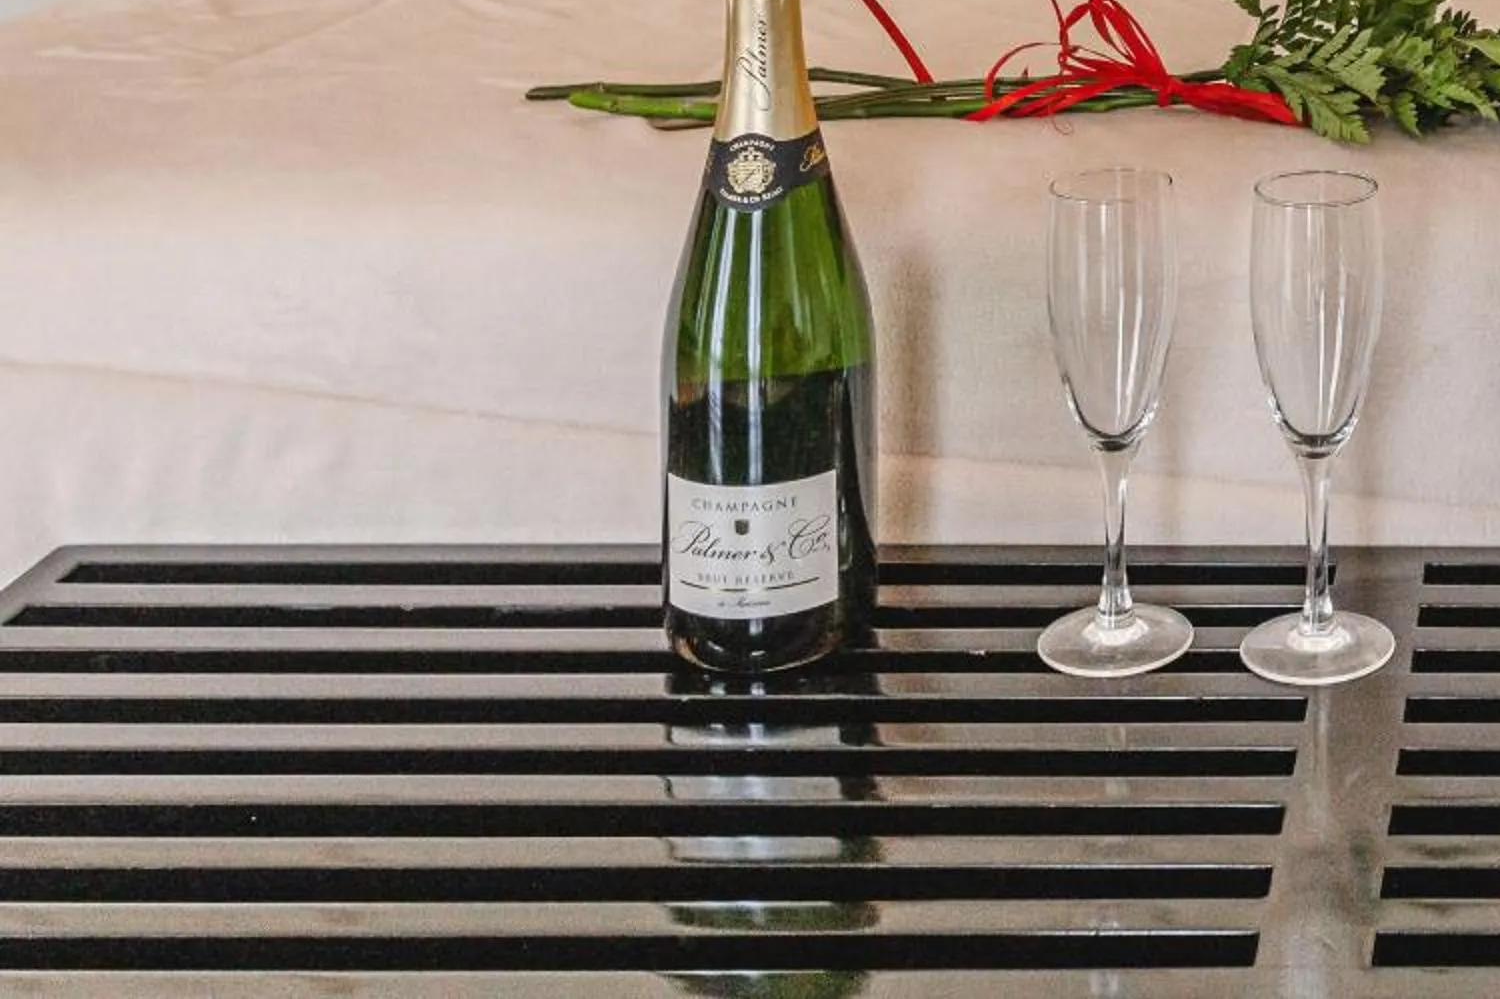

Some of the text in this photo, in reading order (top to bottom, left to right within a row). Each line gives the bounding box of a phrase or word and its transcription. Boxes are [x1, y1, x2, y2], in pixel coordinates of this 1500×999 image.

[736, 18, 771, 112] Palmer
[691, 497, 798, 512] CHAMPAGNE
[672, 520, 757, 560] Palmer
